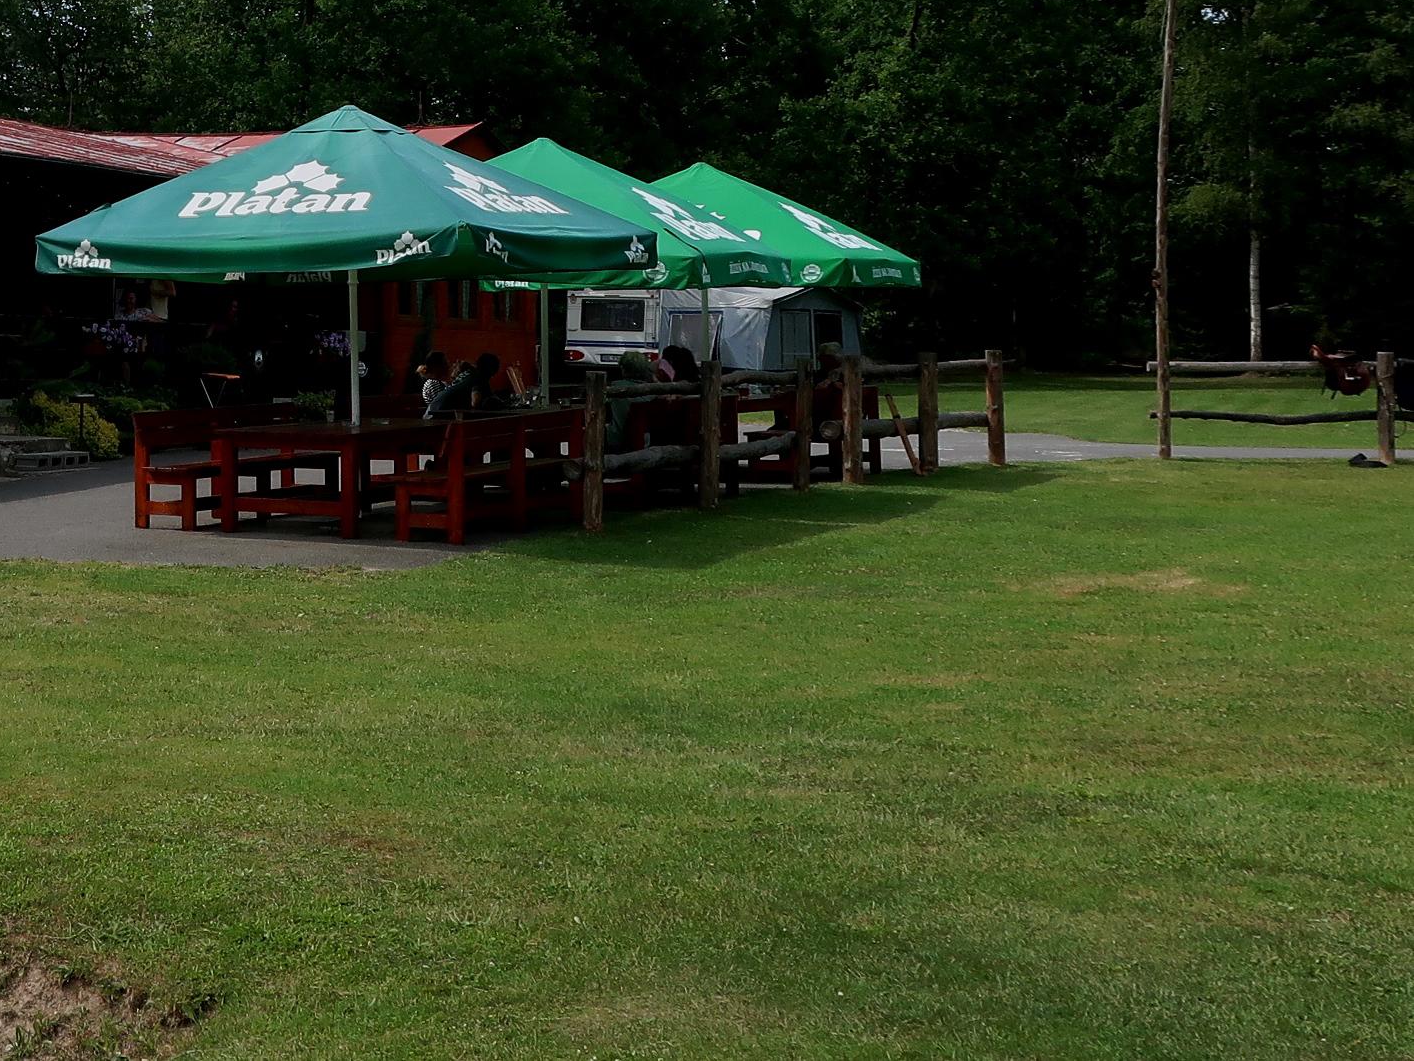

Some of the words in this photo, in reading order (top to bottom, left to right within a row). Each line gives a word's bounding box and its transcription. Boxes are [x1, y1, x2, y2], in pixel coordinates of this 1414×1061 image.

[178, 187, 371, 218] Platan
[443, 185, 571, 214] Platan
[57, 254, 112, 270] Platan
